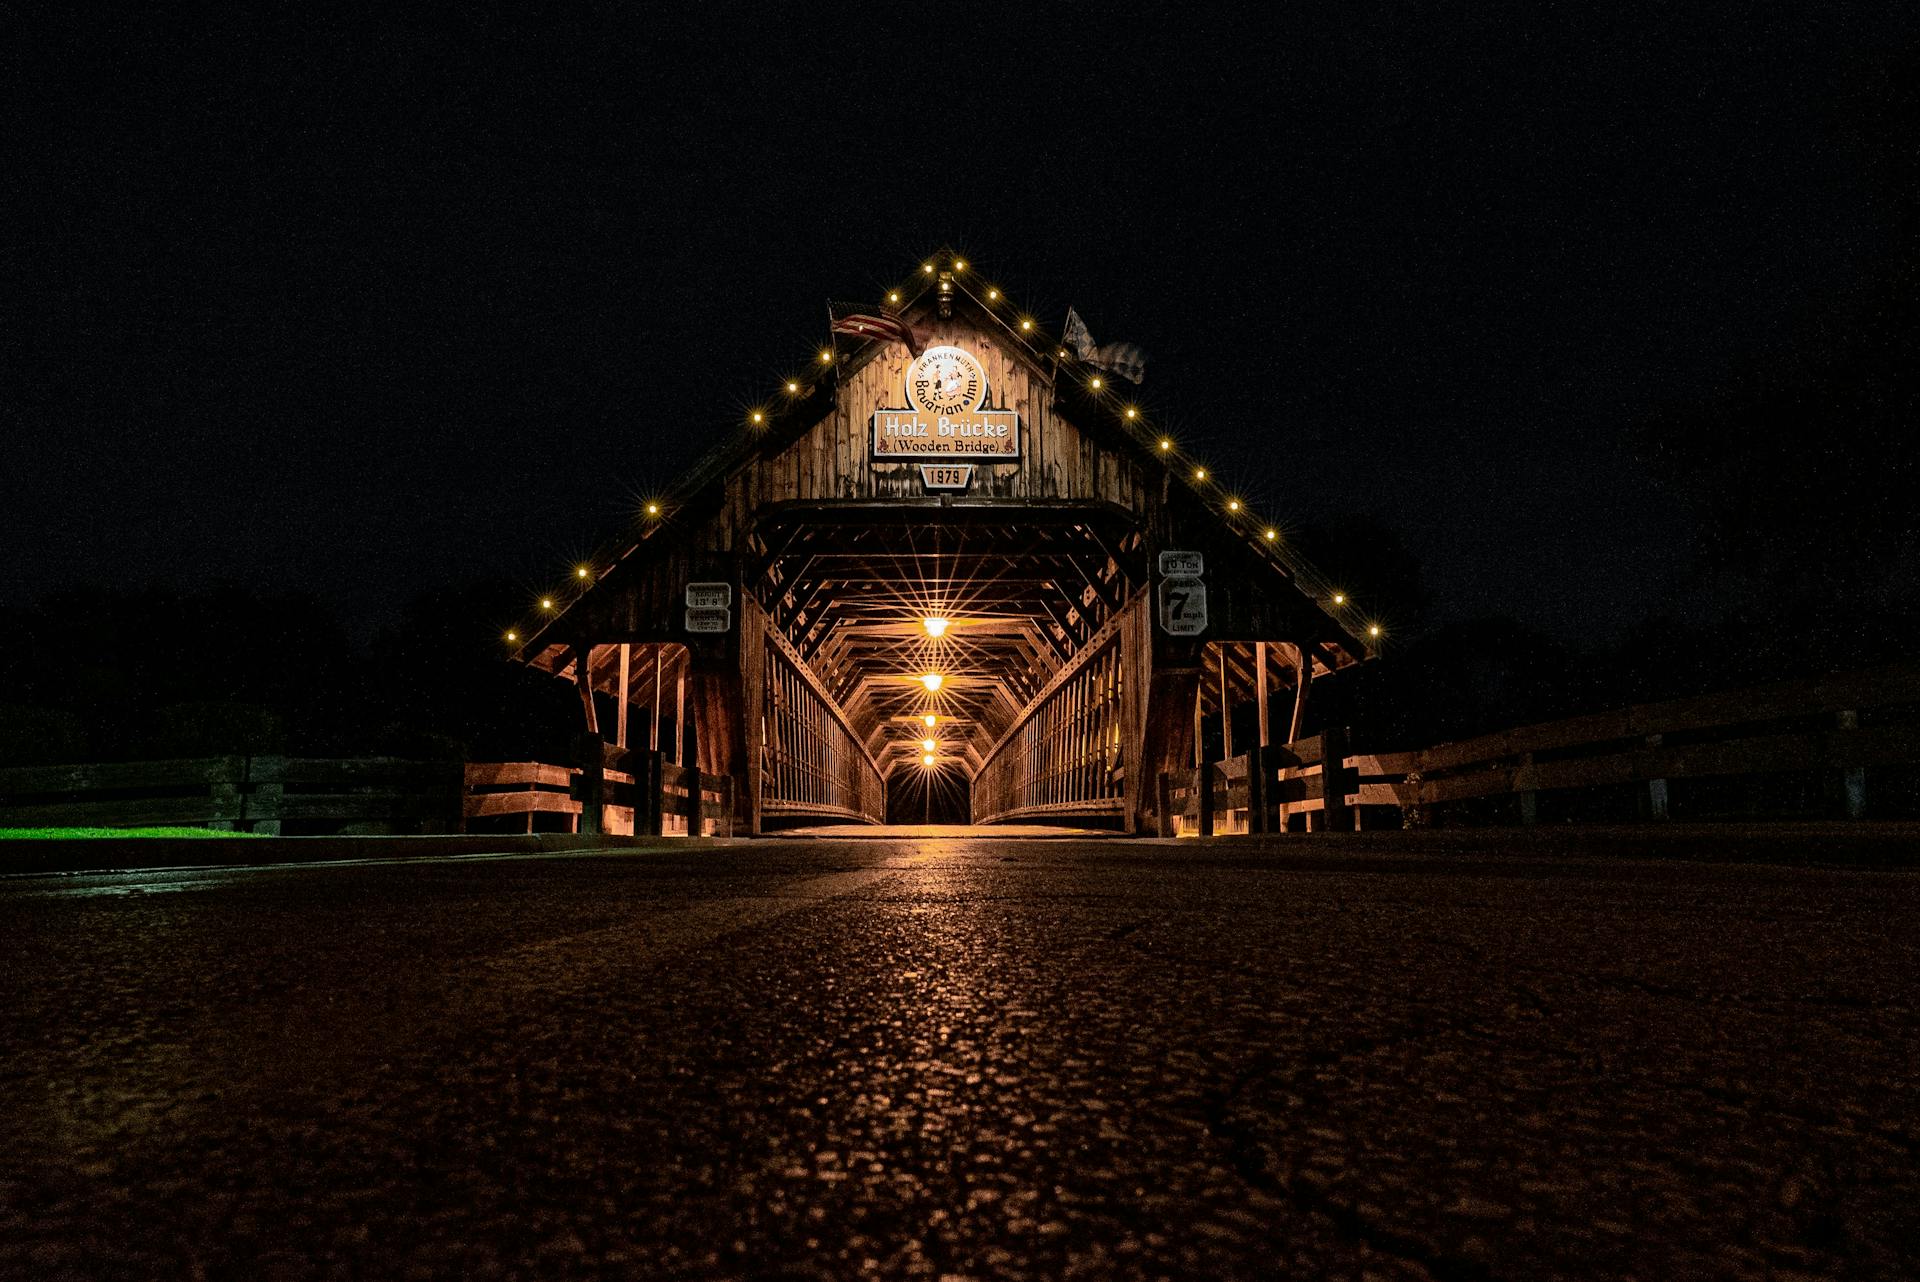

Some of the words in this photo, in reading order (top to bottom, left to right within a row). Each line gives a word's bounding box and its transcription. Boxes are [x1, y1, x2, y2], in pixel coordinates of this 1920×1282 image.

[919, 353, 974, 373] FRANKENMUTH
[915, 380, 964, 415] Bavarian
[962, 380, 977, 401] Inn
[885, 416, 929, 437] Holz
[937, 416, 1008, 438] Brücke
[893, 440, 950, 453] (Wooden
[955, 440, 999, 453] Bridge)
[930, 471, 960, 484] 1979
[1165, 592, 1190, 620] 7
[1172, 624, 1195, 632] LIMIT
